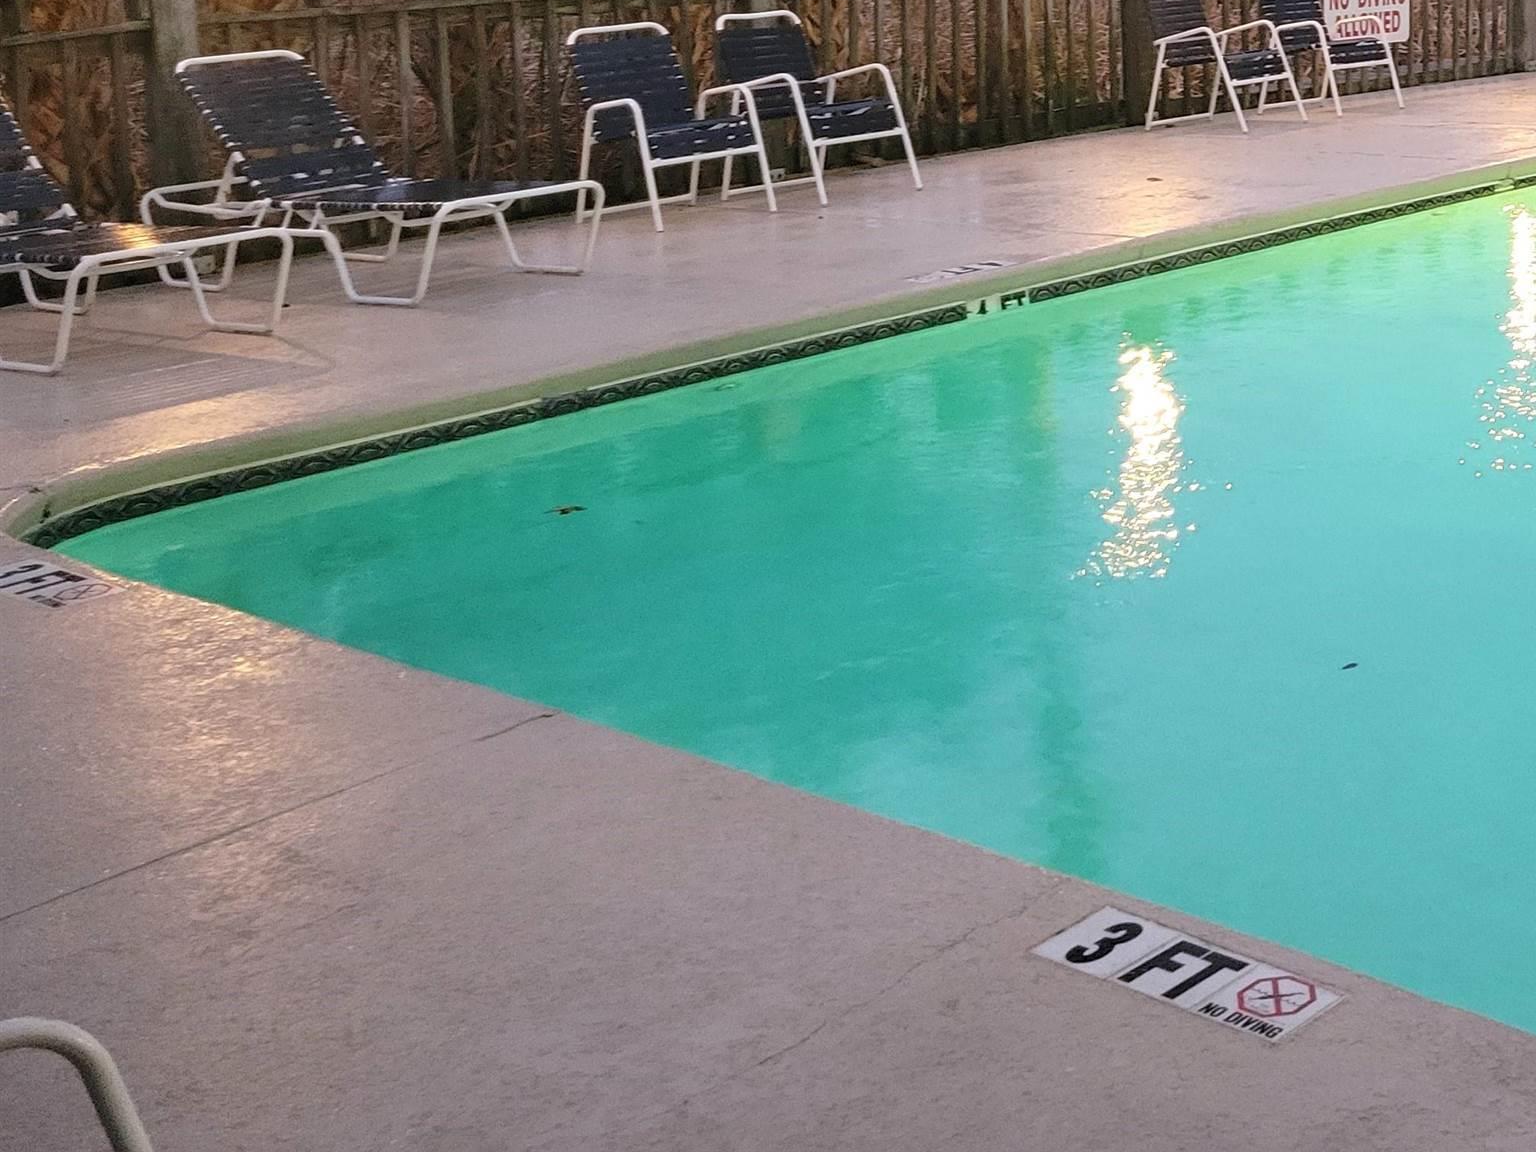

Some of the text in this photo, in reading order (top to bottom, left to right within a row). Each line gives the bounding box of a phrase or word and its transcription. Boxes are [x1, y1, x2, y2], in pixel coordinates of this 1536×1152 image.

[1065, 922, 1250, 1000] 3 FT
[1197, 1002, 1284, 1039] NO DIVING
